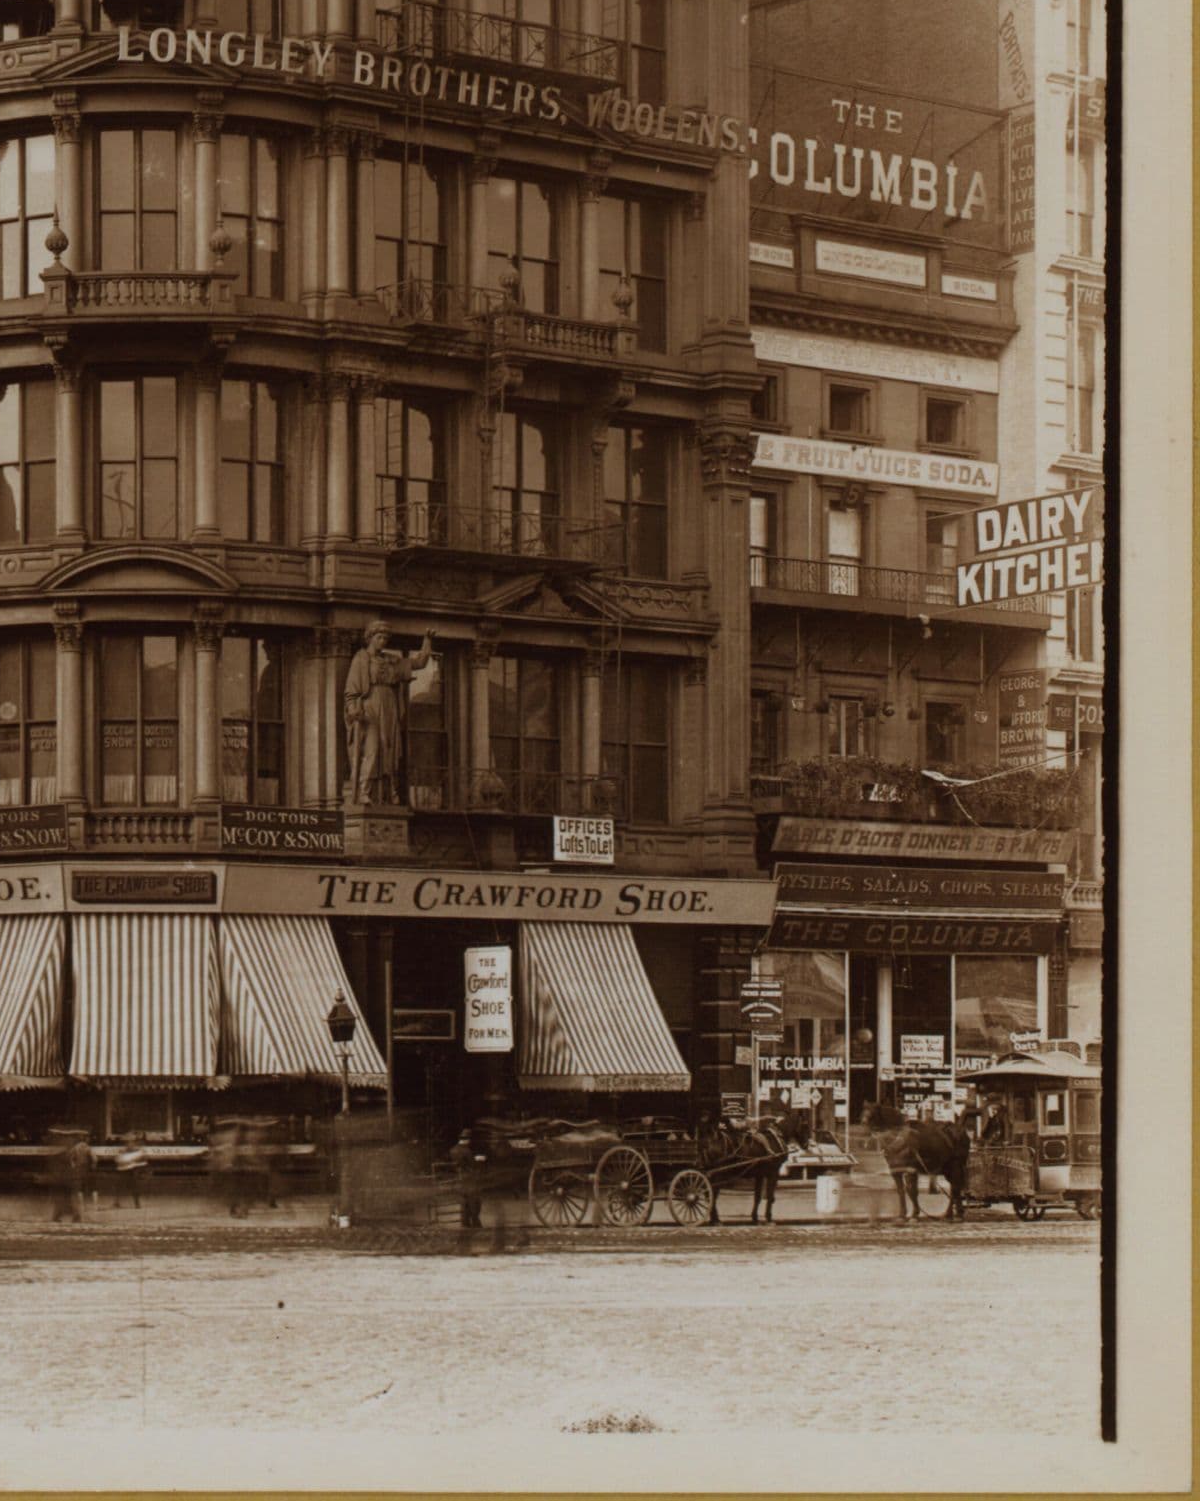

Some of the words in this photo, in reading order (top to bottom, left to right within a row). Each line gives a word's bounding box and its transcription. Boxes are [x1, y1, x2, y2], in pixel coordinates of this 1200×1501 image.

[117, 25, 333, 78] LONGLEY
[353, 49, 569, 126] BROTHERS,
[586, 87, 748, 154] WOOLENS.
[831, 99, 904, 135] THE
[782, 442, 848, 471] FRUIT
[855, 449, 922, 479] JUICE
[929, 460, 992, 489] SODA.
[976, 491, 1092, 553] DAIRY
[1000, 675, 1040, 692] GEORGE
[245, 810, 319, 825] DOCTORS
[559, 818, 611, 836] OFFICES
[1, 831, 12, 847] &
[13, 827, 67, 847] SNOW.
[283, 831, 297, 848] &
[297, 830, 344, 850] SNOW.
[560, 834, 584, 853] Lofts
[584, 835, 596, 854] To
[597, 837, 613, 855] Let
[780, 826, 838, 846] TABLE
[839, 828, 902, 848] D'HOTE
[906, 832, 972, 851] DINNER
[73, 875, 102, 896] THE
[105, 875, 170, 896] CRAWFORD
[172, 875, 209, 897] SHOE
[319, 874, 397, 909] THE
[413, 877, 603, 912] CRAWFORD
[615, 884, 714, 916] SHOE.
[863, 876, 932, 896] SALADS,
[783, 920, 851, 942] THE
[865, 924, 1033, 947] COLUMBIA
[478, 957, 497, 967] THE
[467, 971, 508, 994] Crawford
[471, 999, 505, 1018] SHOE
[468, 1027, 485, 1039] FOR
[758, 1056, 782, 1071] THE
[784, 1056, 845, 1071] COLUMBIA
[956, 1057, 989, 1070] DAIRY
